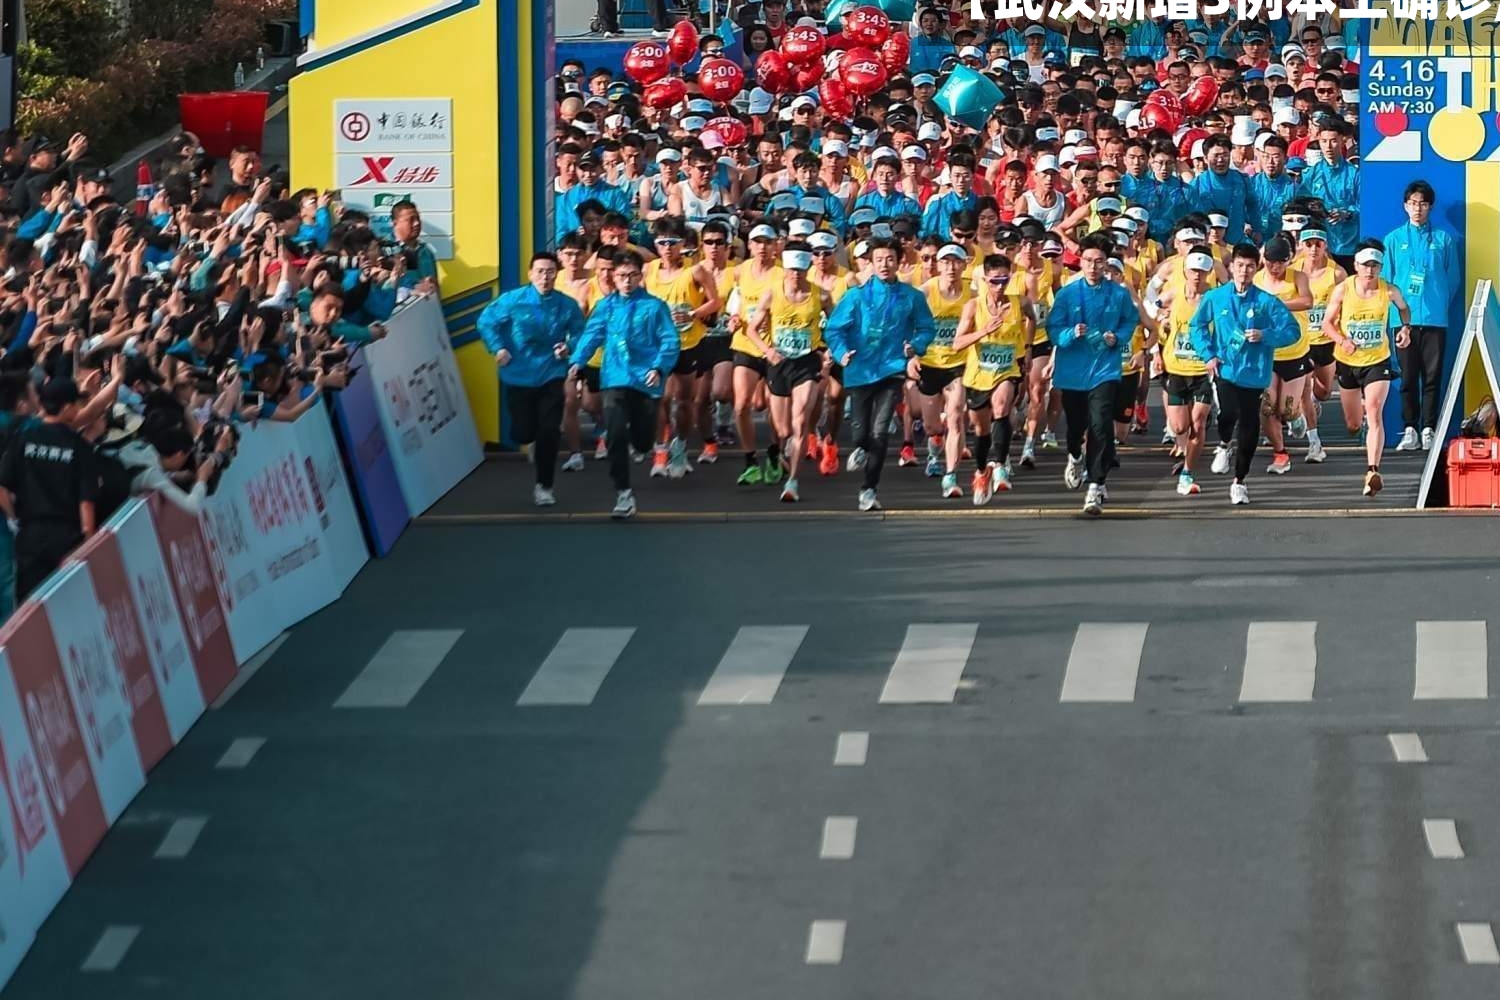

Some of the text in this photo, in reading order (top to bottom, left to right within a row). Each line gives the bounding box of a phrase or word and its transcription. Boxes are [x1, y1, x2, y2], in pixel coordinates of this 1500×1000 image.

[857, 12, 887, 27] 3:45
[786, 31, 817, 42] 3:45
[631, 46, 663, 57] 5:00
[705, 66, 737, 78] 3:00
[1368, 60, 1435, 82] 4.16
[1368, 83, 1435, 99] Sunday
[1368, 101, 1435, 114] AM 7:30
[392, 166, 440, 183] 特步
[1349, 331, 1381, 341] Y0018
